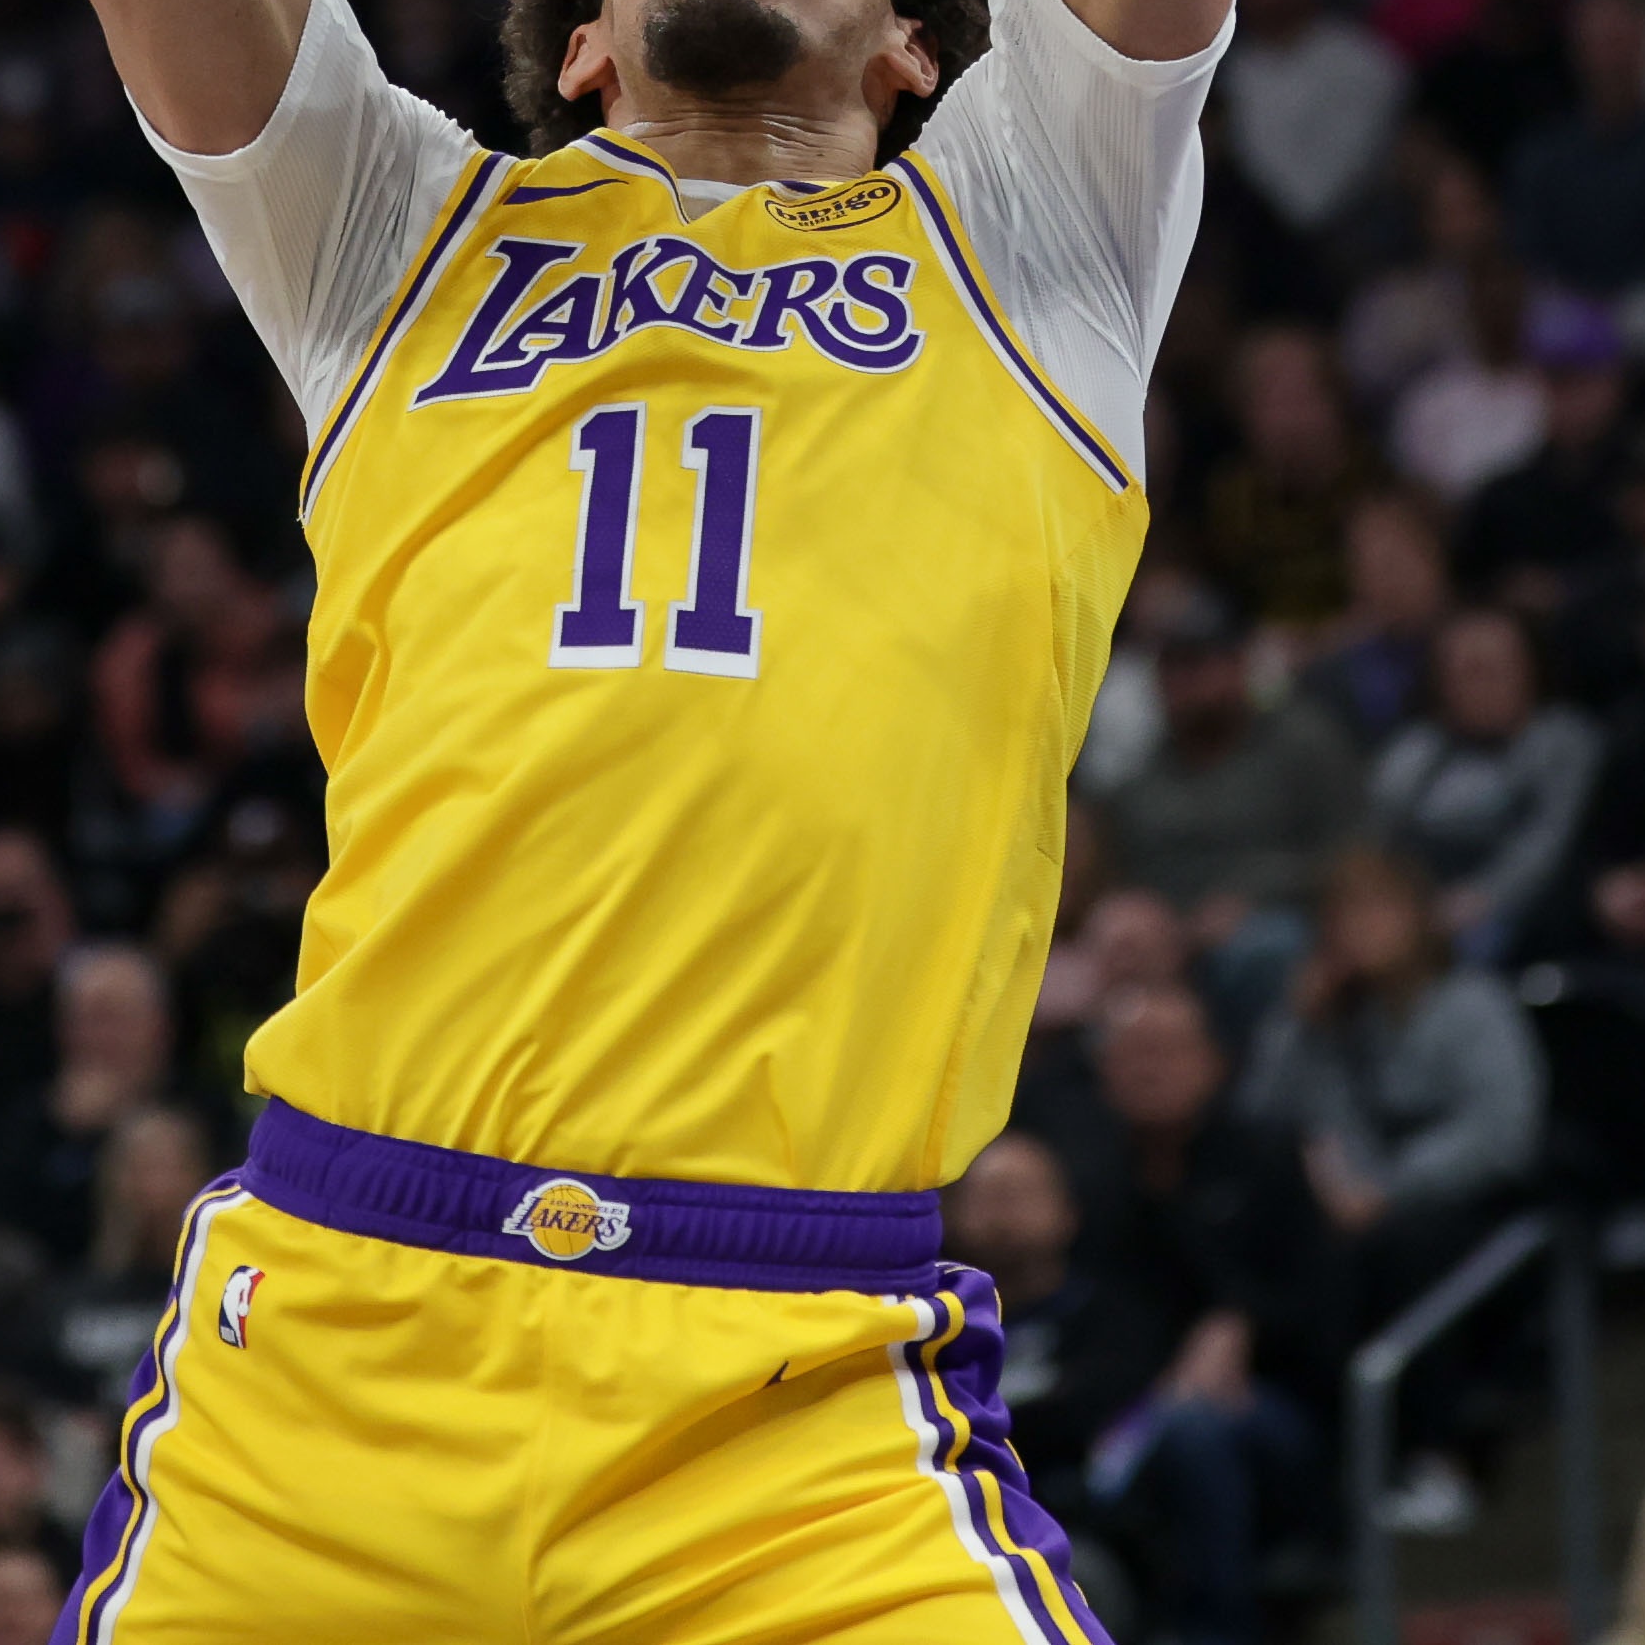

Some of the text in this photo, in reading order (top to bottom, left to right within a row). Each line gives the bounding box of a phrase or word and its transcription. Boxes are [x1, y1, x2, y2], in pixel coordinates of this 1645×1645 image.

[774, 186, 891, 222] bibigo
[408, 234, 925, 412] LAKERS
[547, 401, 763, 679] 11
[511, 1196, 625, 1245] LAKERS
